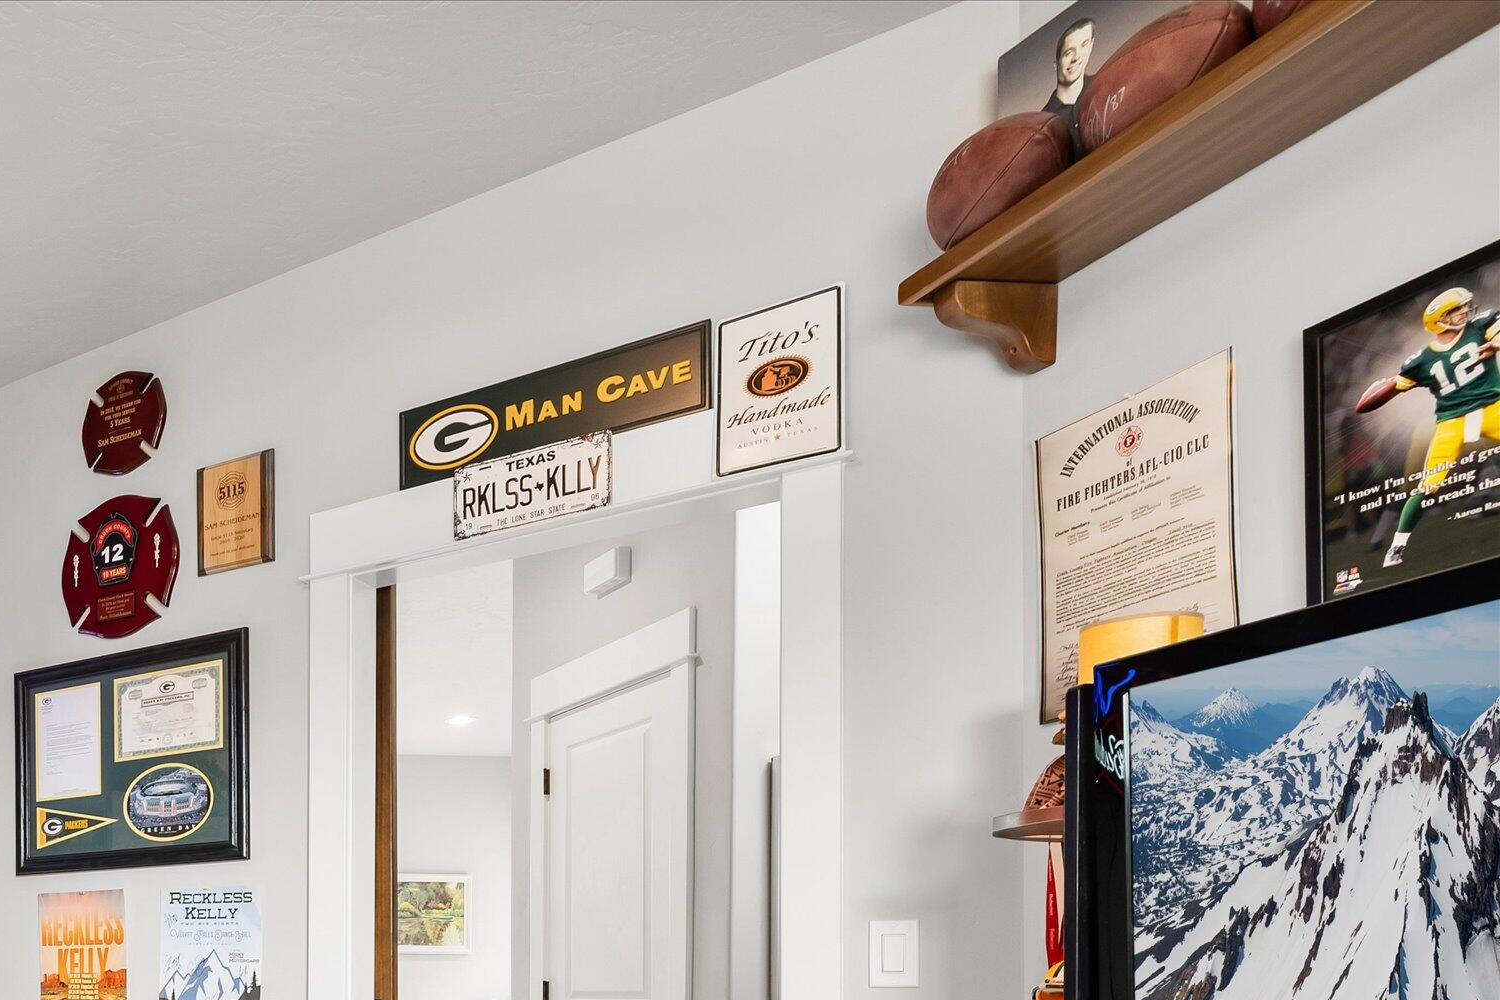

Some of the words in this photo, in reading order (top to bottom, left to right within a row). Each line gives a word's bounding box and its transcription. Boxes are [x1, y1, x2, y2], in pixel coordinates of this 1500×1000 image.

[738, 320, 819, 363] Tito's
[1430, 342, 1485, 396] 12
[505, 390, 583, 432] MAN
[596, 360, 692, 403] CAVE
[726, 386, 831, 429] Handmade
[752, 418, 804, 436] VODKA
[1060, 408, 1134, 478] INTERNATIONAL
[1136, 398, 1201, 424] ASSOCIATION
[505, 450, 556, 472] TEXAS
[1056, 491, 1081, 512] FIRE
[1187, 434, 1210, 456] CLC
[1349, 484, 1381, 502] know
[1384, 477, 1405, 491] I'm
[1408, 460, 1457, 483] capable
[1460, 450, 1477, 465] of
[219, 482, 245, 500] 5115
[463, 470, 533, 521] RKLSS
[546, 455, 601, 501] KLLY
[1360, 496, 1383, 513] and
[1385, 490, 1407, 505] I'm
[1410, 469, 1477, 496] expecting
[1421, 498, 1435, 509] to
[1438, 484, 1476, 504] reach
[497, 516, 509, 527] THE
[511, 512, 528, 525] LONE
[529, 508, 546, 521] STAR
[548, 503, 566, 517] STATE
[1453, 506, 1483, 521] Aaron
[101, 543, 124, 564] 12
[109, 566, 127, 578] YEARS
[170, 892, 253, 905] RECKLESS
[185, 907, 238, 920] KELLY
[41, 913, 125, 947] RECKLESS
[58, 948, 109, 978] KELLY
